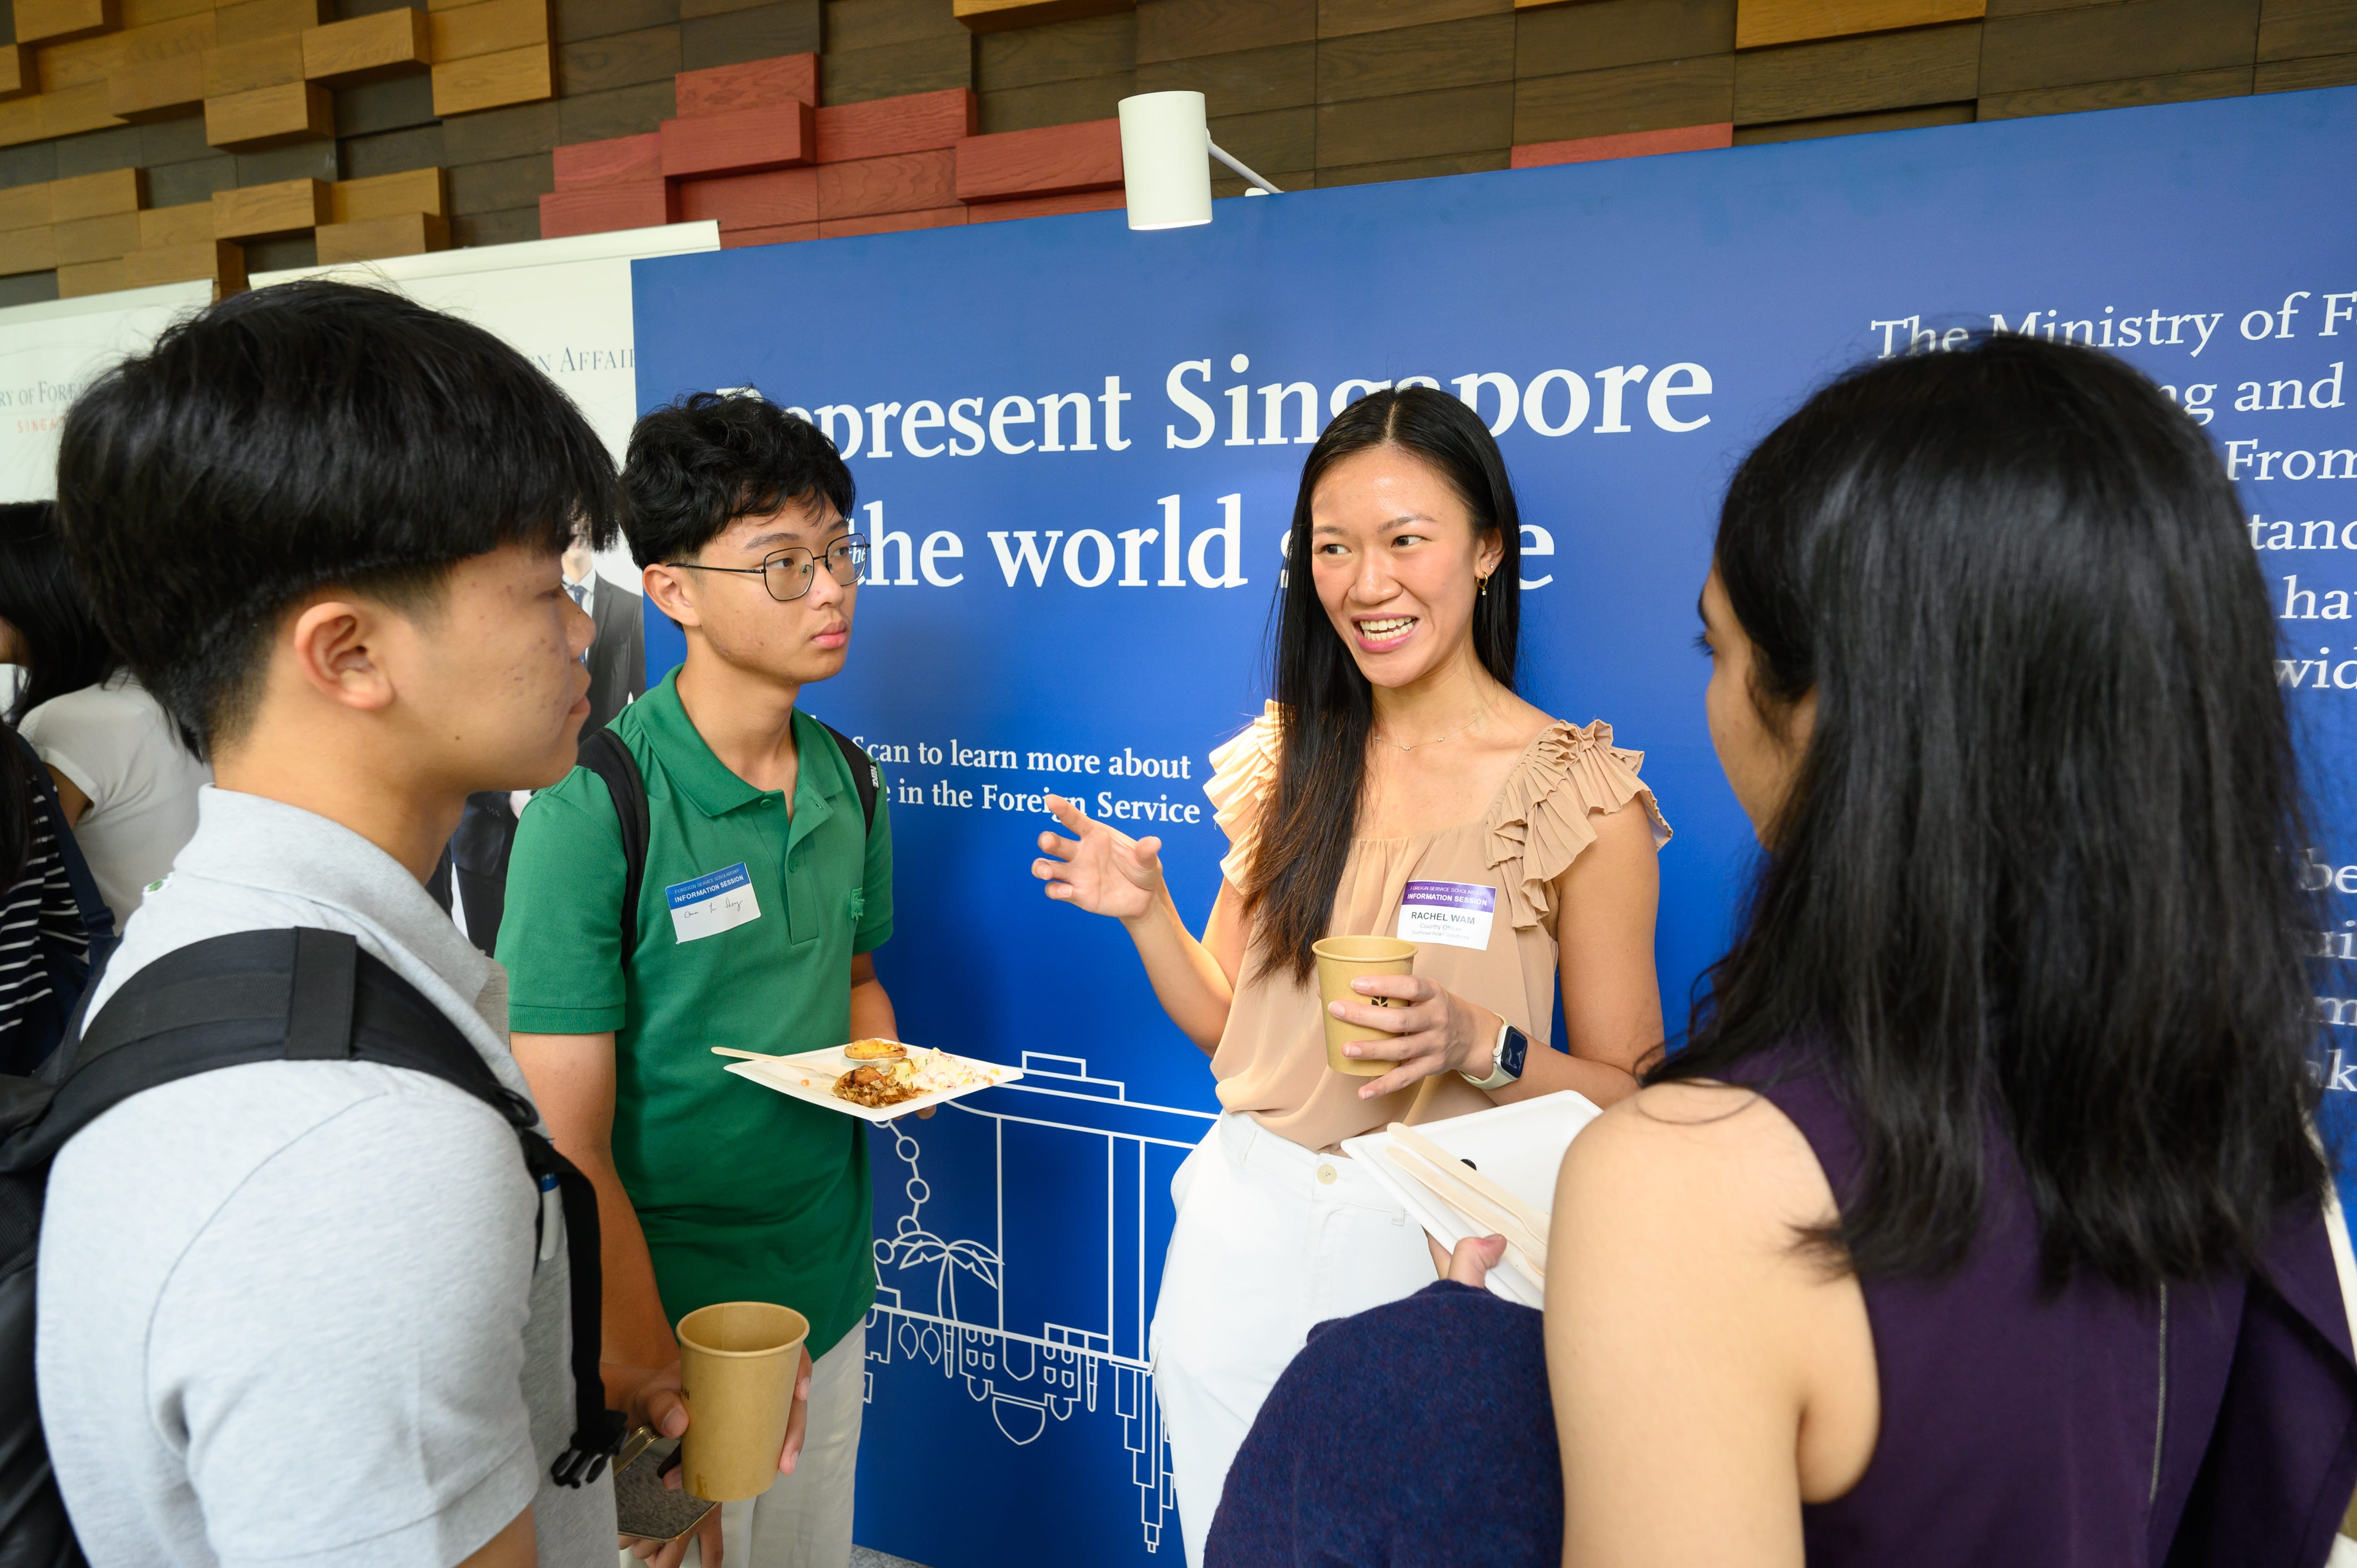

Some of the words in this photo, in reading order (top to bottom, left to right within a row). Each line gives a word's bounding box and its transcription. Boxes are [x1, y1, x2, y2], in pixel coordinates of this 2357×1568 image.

[1871, 315, 1969, 359] The
[1989, 305, 2224, 358] Ministry
[2239, 292, 2310, 341] of
[2318, 291, 2357, 337] F
[19, 388, 34, 406] OF
[2234, 361, 2345, 411] and
[717, 376, 1131, 460] present
[1166, 353, 1713, 449] Sinpore
[988, 493, 1248, 588] world
[2278, 575, 2357, 620] ha
[852, 736, 910, 763] Scan
[918, 742, 942, 765] to
[950, 739, 1018, 770] learn
[1026, 751, 1100, 774] more
[1109, 747, 1191, 779] about
[870, 765, 879, 788] NIKE
[898, 778, 924, 804] in
[931, 780, 973, 808] the
[981, 784, 1087, 822] Forein
[1097, 791, 1201, 824] Service
[675, 885, 697, 894] FOREIGN
[697, 877, 714, 887] SERVICE
[714, 869, 740, 881] SCHOLARSHIP
[675, 884, 720, 903] INFORMATION
[720, 874, 744, 888] SESSION
[1451, 887, 1486, 895] SCHOLARSHIP
[1407, 893, 1452, 902] INFORMATION
[1454, 895, 1488, 906] SESSION
[1411, 911, 1448, 921] RACHEL
[1451, 914, 1475, 925] WAM
[1420, 923, 1441, 931] Country
